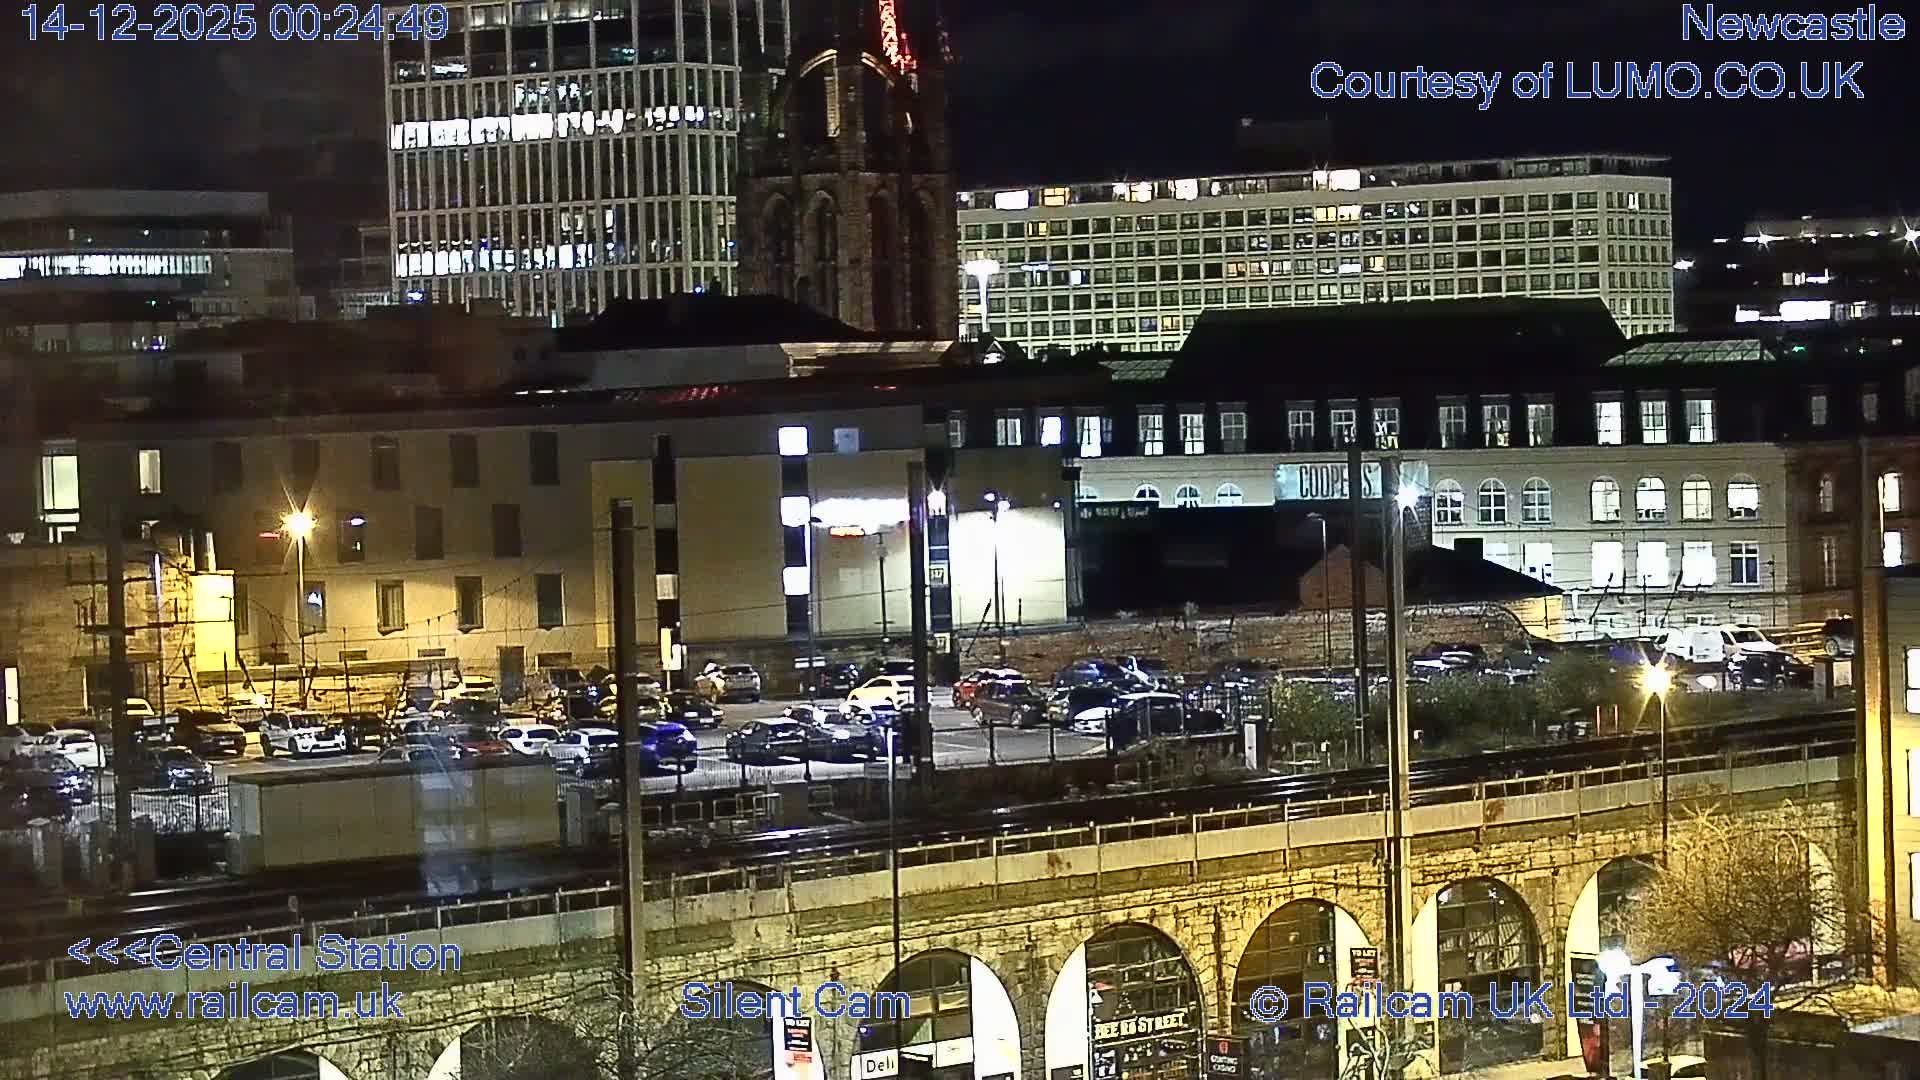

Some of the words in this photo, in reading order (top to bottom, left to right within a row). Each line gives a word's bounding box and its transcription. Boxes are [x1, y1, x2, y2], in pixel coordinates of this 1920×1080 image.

[1299, 464, 1373, 498] COOPES
[1137, 1012, 1185, 1034] STREET
[866, 1056, 894, 1073] Deli
